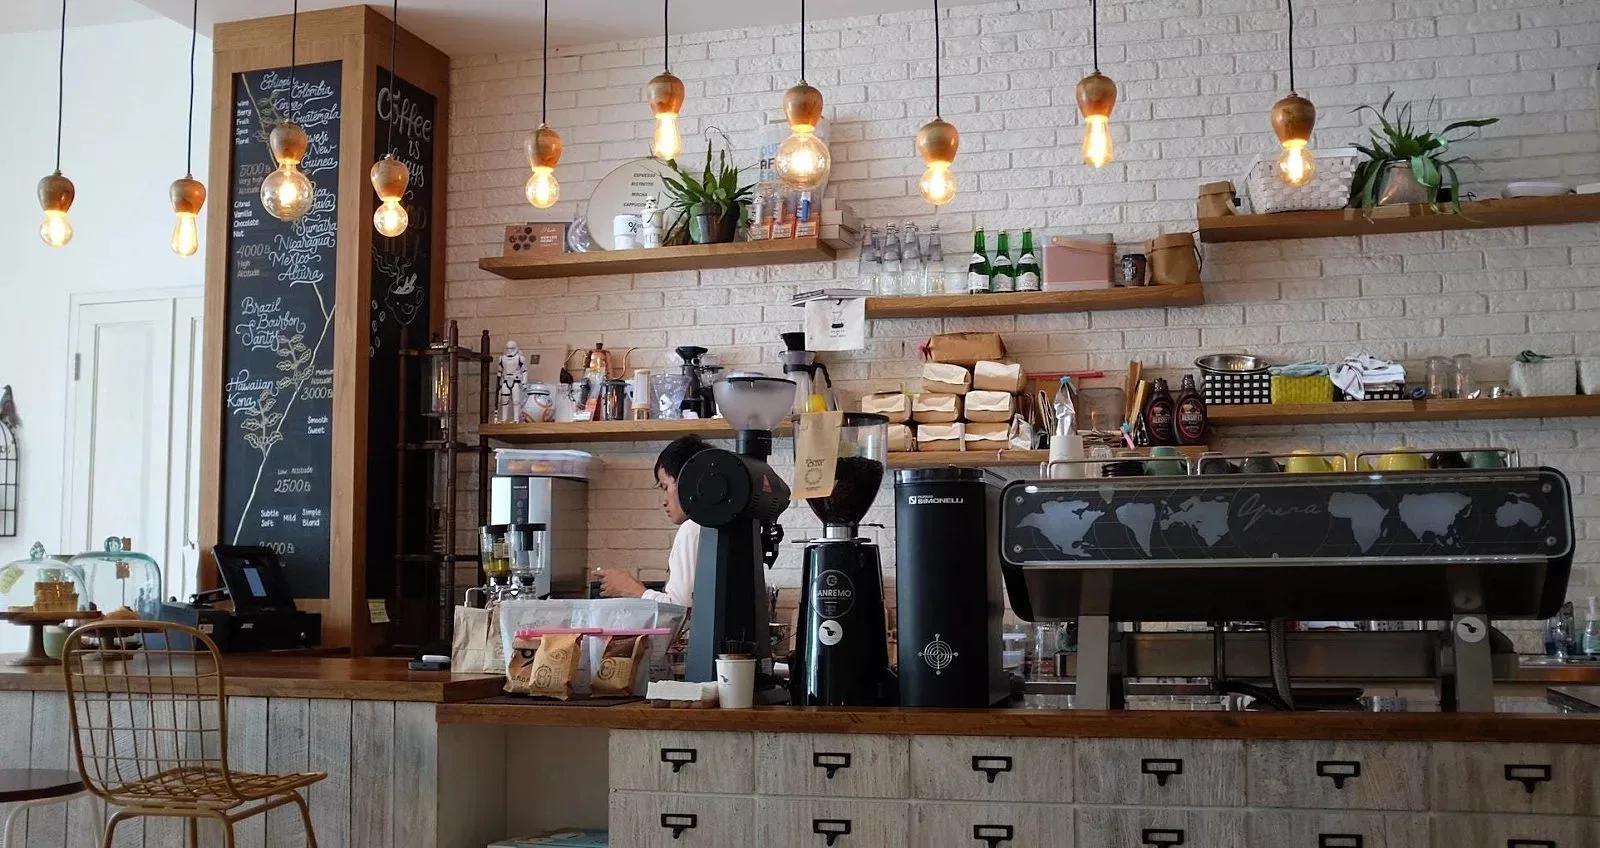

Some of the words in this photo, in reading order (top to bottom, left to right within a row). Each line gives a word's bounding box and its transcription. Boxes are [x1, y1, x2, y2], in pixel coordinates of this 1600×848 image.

[291, 80, 334, 102] Colombia
[292, 103, 340, 126] Guatemala
[378, 87, 432, 141] Coffee
[309, 143, 336, 155] New
[409, 141, 420, 160] is
[302, 155, 338, 173] Guinea
[274, 234, 335, 253] Nicaragua
[268, 251, 322, 267] Mexico
[277, 264, 324, 286] Altura
[241, 296, 281, 315] Brazil
[256, 311, 306, 334] Bourbon
[235, 320, 280, 351] Santos
[226, 369, 279, 396] Hawaiian
[227, 393, 256, 413] Kona
[301, 387, 328, 400] 3000
[307, 416, 329, 425] Smooth
[307, 426, 325, 434] Sweet
[273, 479, 304, 493] 2500
[260, 508, 279, 518] Subtle
[283, 514, 297, 522] Mild
[302, 508, 321, 518] Simple
[1237, 493, 1322, 532] Opera
[815, 589, 852, 598] ANREMO
